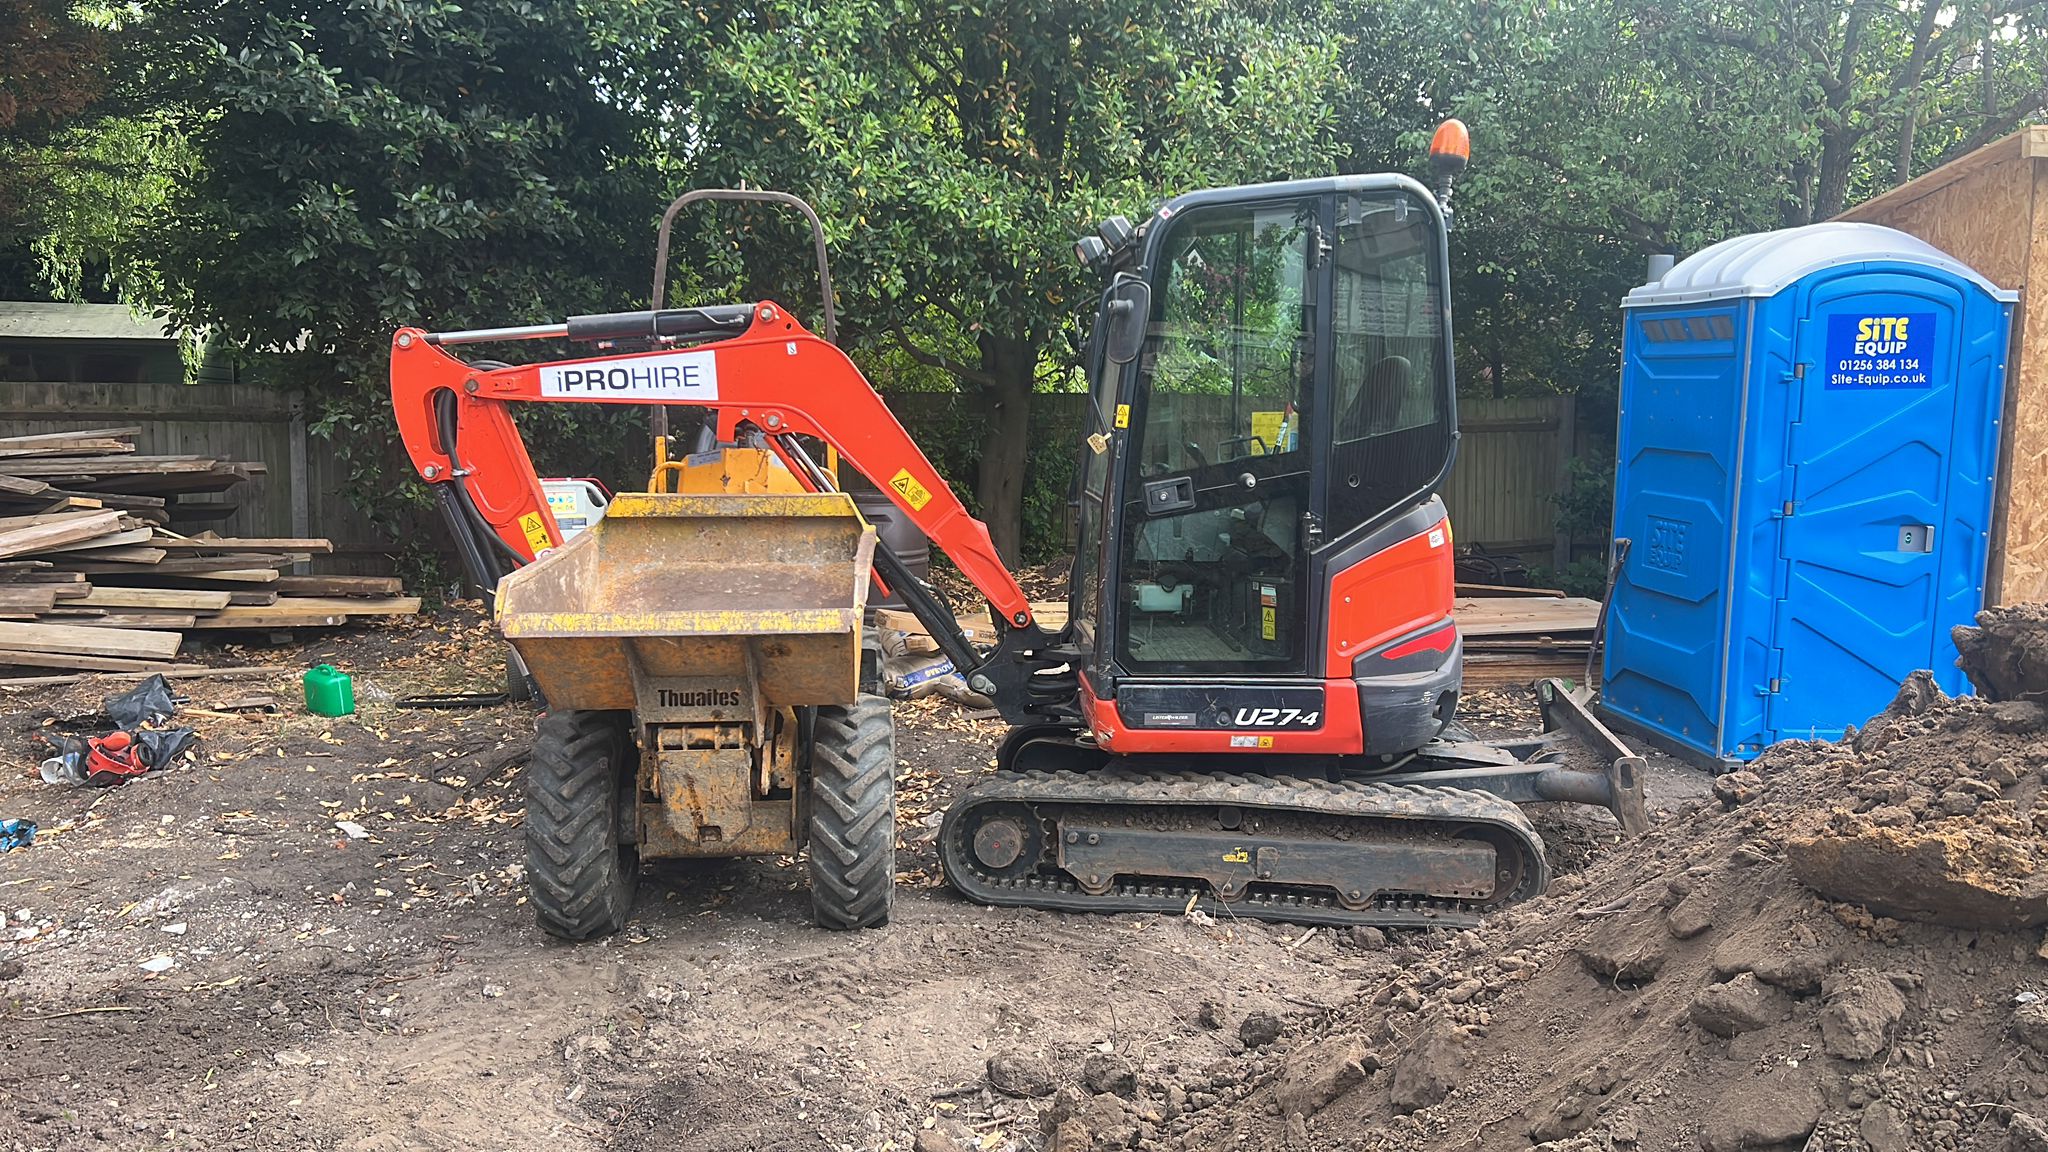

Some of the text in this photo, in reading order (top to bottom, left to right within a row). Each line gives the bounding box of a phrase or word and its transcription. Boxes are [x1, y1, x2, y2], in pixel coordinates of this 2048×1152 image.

[1854, 341, 1907, 356] EQUIP
[1839, 359, 1919, 371] 01256 384 134
[1831, 373, 1926, 386] Site-Equip.co.uk
[1649, 548, 1683, 570] EQUIP
[658, 689, 739, 707] Thwaites
[1234, 708, 1319, 726] U27-4
